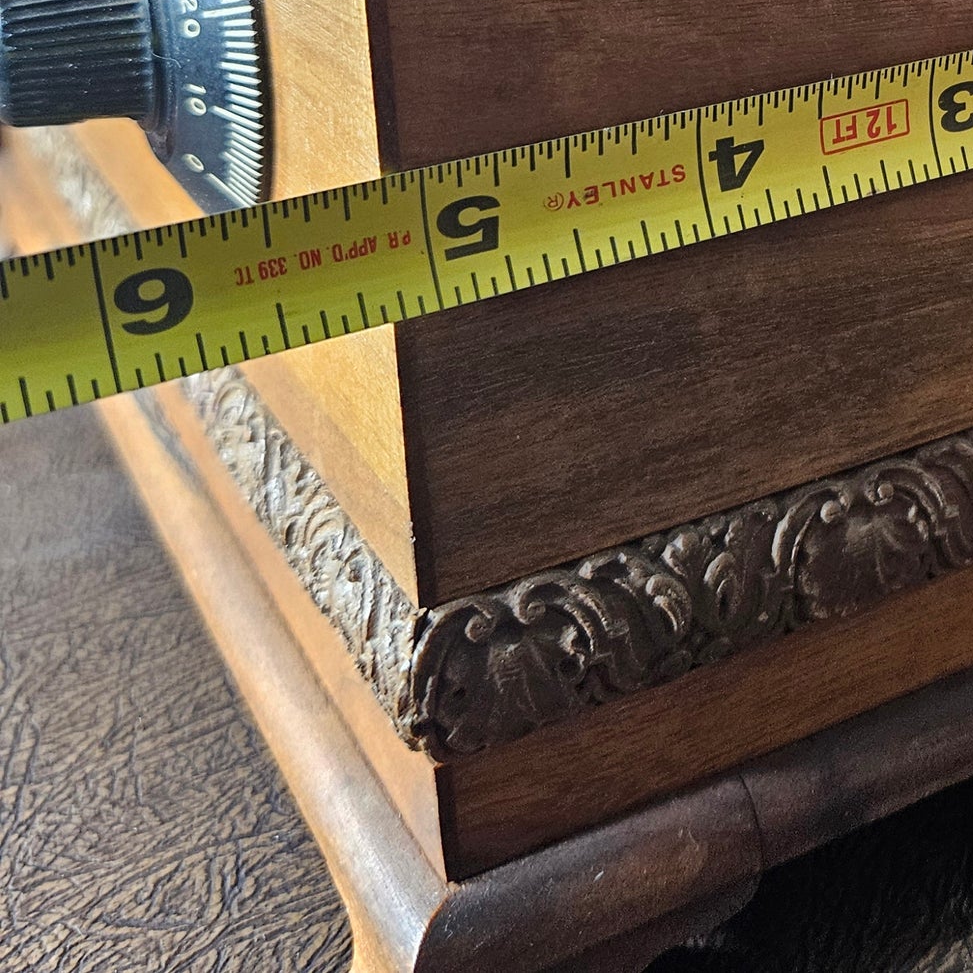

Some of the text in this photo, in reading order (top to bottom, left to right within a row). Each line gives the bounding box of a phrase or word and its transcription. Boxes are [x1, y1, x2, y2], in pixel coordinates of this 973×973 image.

[183, 82, 207, 117] 10
[832, 106, 898, 145] 12 FT
[708, 136, 765, 193] 4
[436, 195, 501, 261] 5
[234, 265, 254, 287] TC
[258, 257, 287, 280] 339
[112, 267, 194, 336] 6
